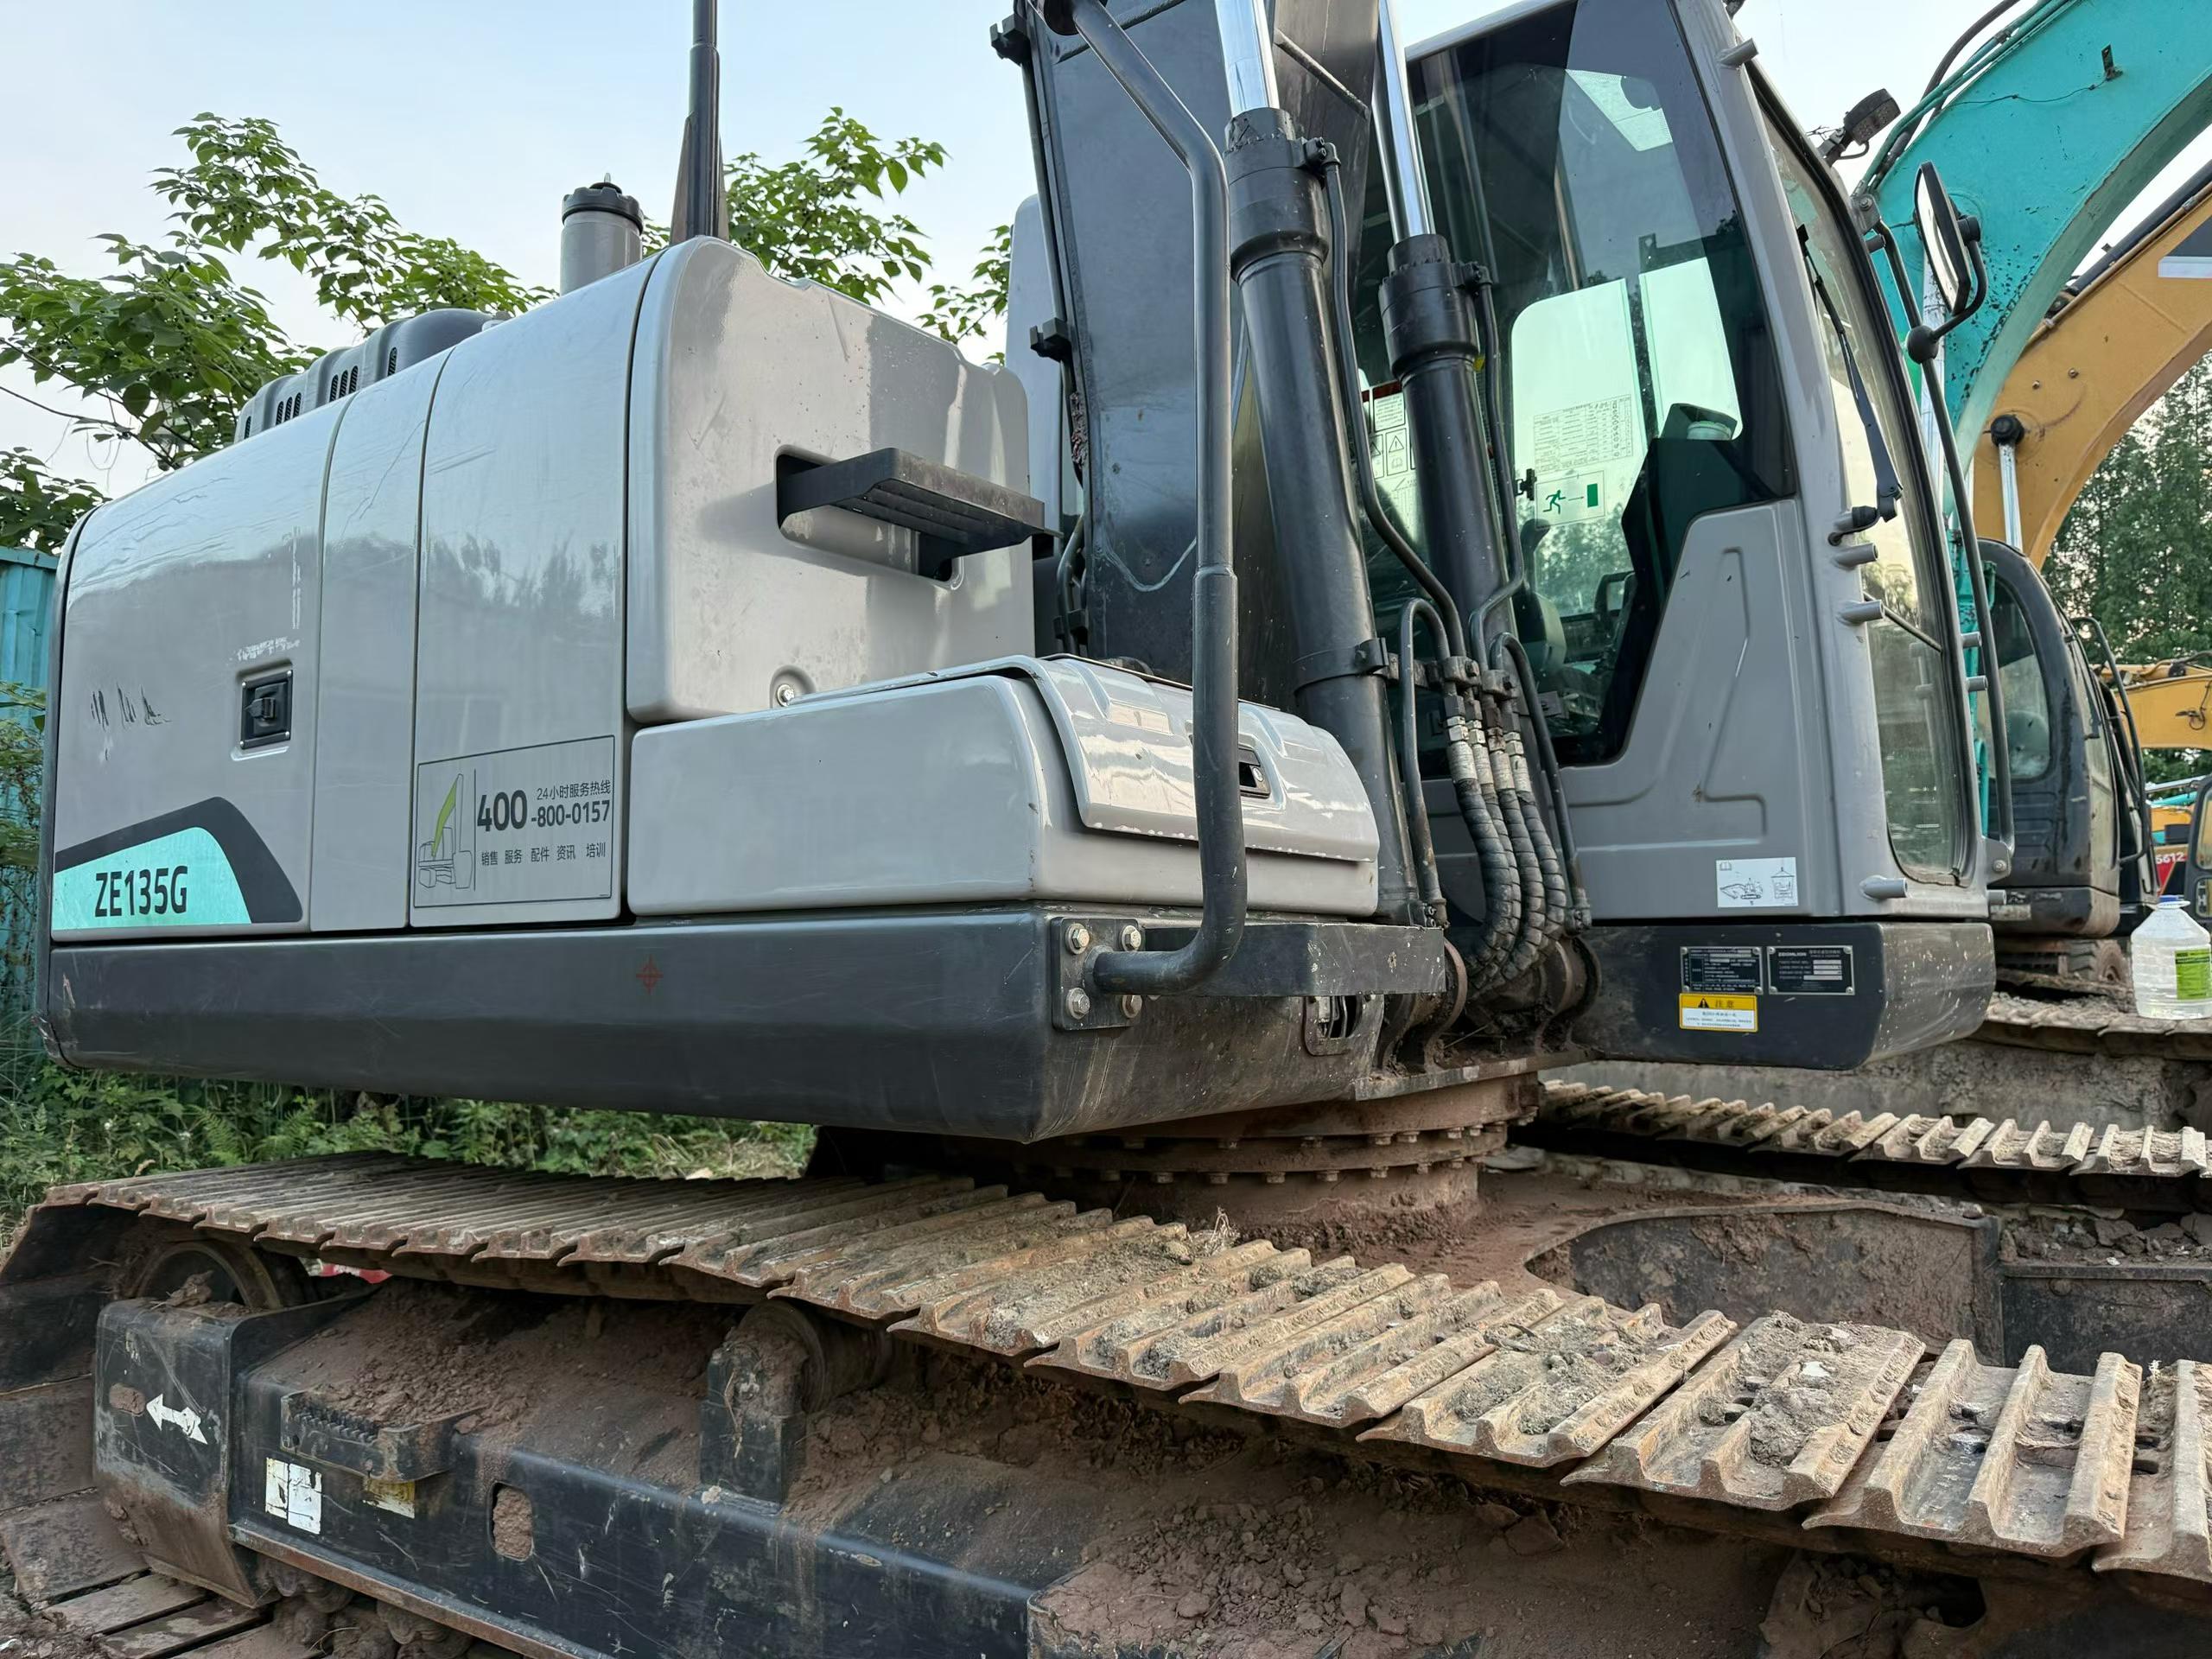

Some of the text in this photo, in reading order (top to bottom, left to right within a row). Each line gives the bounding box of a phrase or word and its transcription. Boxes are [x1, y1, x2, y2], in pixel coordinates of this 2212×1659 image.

[537, 779, 611, 800] 24小时服务热线
[481, 842, 606, 867] 销售 服务 配件 资讯 培训
[94, 865, 188, 918] ZE135G
